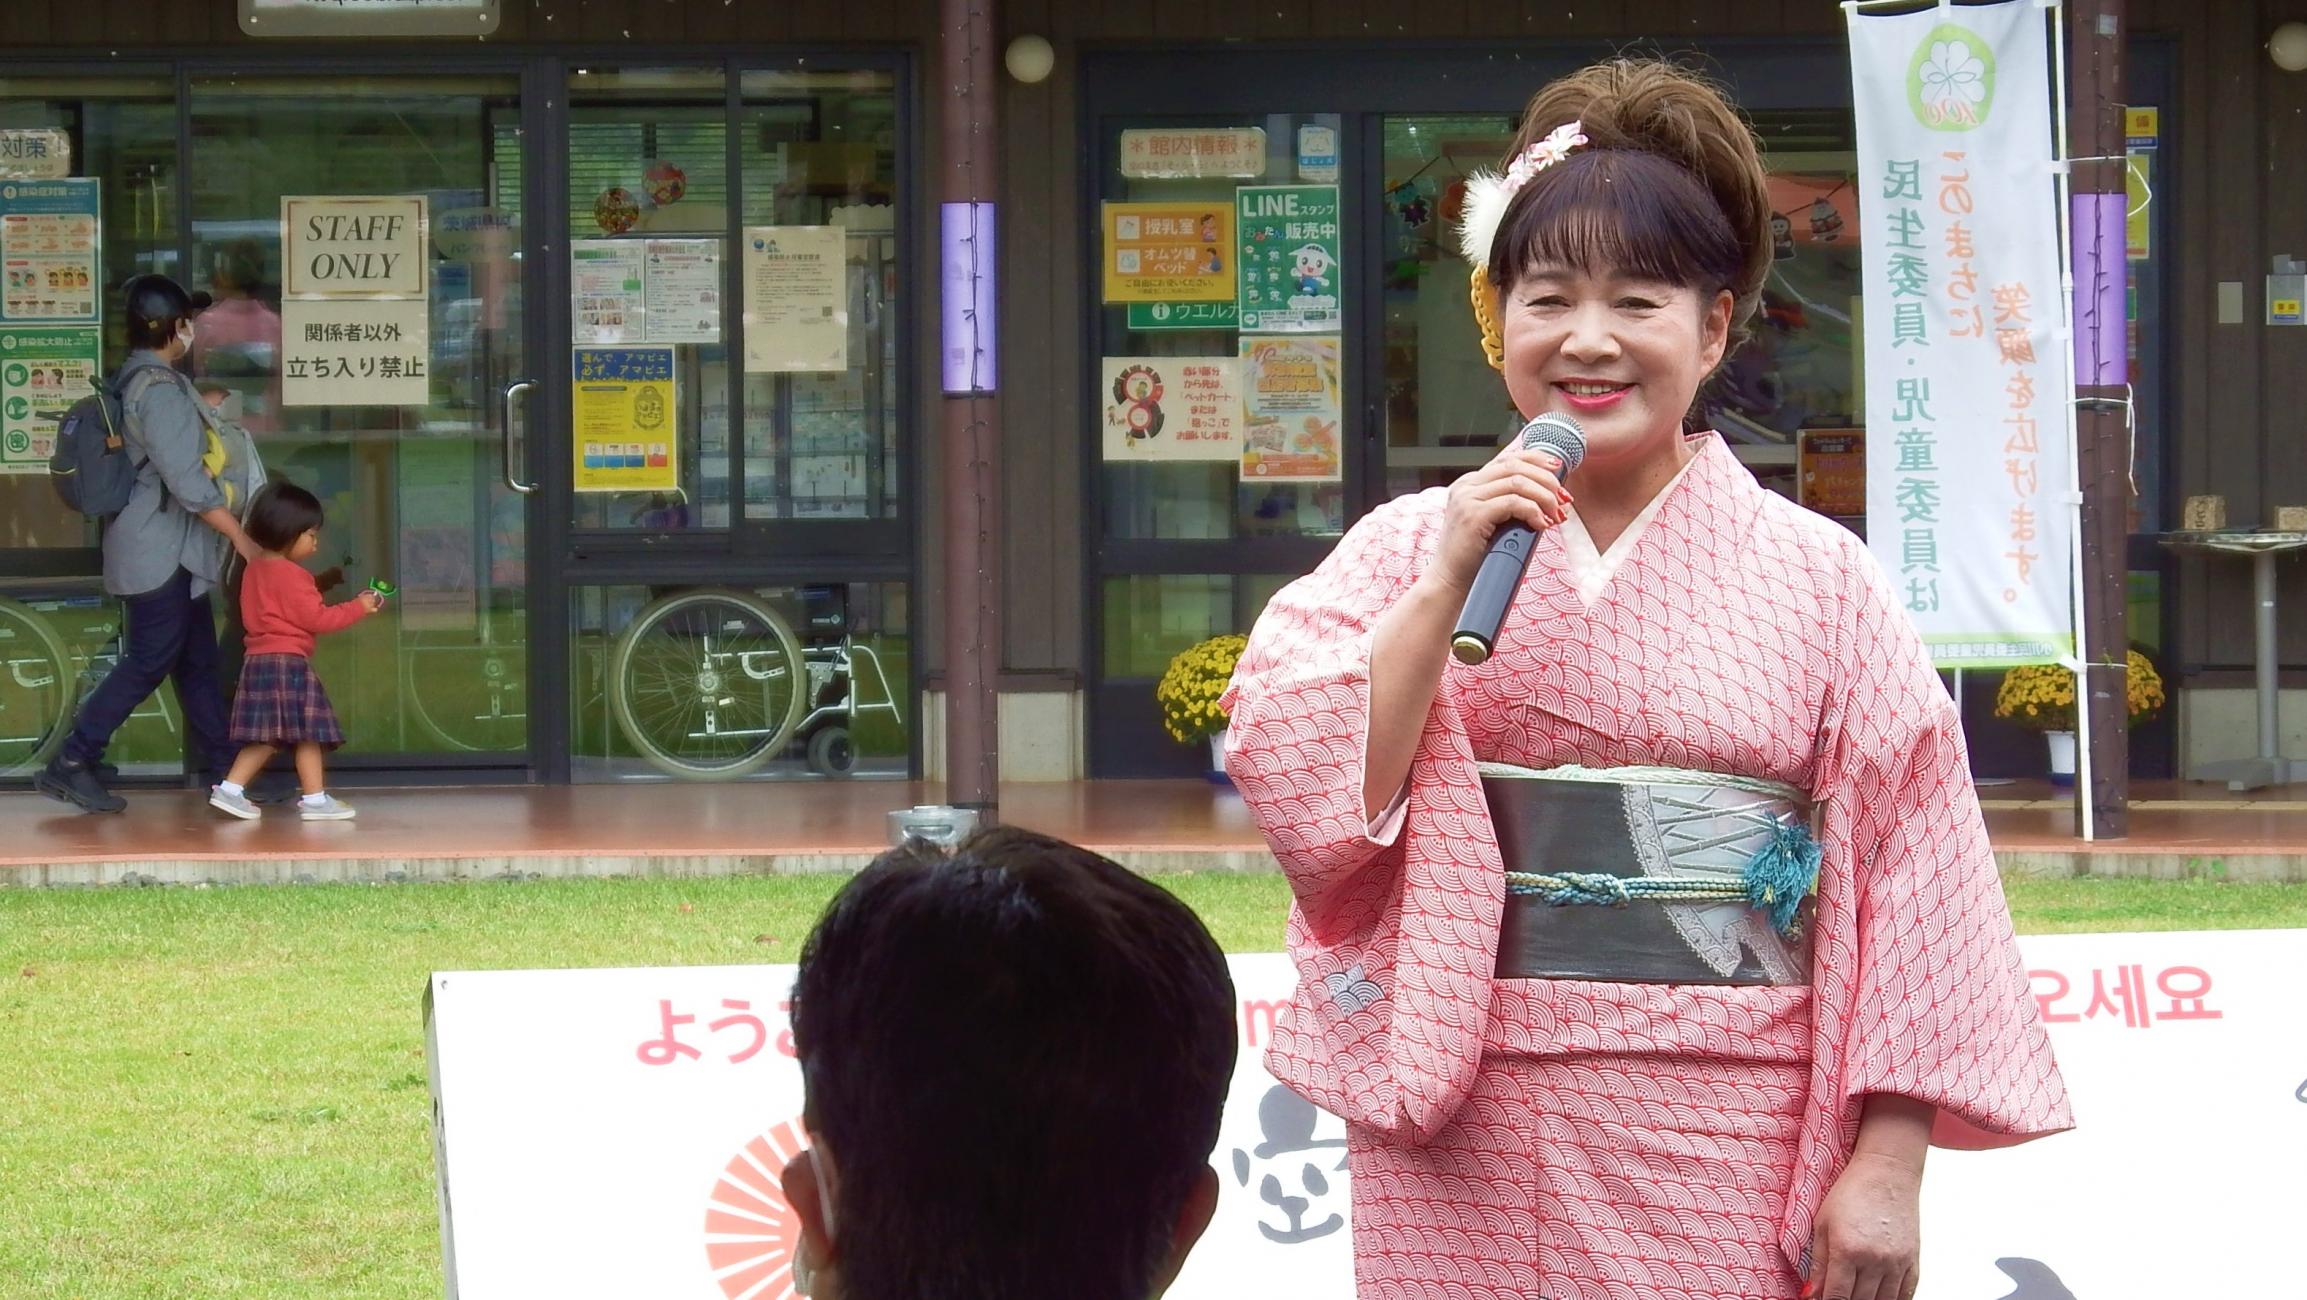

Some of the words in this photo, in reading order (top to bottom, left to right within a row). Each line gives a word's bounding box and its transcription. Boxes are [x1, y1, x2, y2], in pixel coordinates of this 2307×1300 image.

[1149, 135, 1238, 156] 館内情報
[1243, 194, 1299, 217] LINE
[1300, 204, 1336, 216] スタンプ
[306, 215, 404, 241] STAFF
[1145, 218, 1195, 235] 授乳室
[1285, 222, 1336, 240] 販売中
[1145, 247, 1197, 261] オムツ替
[311, 253, 400, 279] ONLY
[1154, 261, 1187, 273] ベッド
[305, 323, 402, 342] 関係者以外
[286, 356, 425, 379] 立ち入り禁止
[2028, 964, 2224, 1029] 오세요
